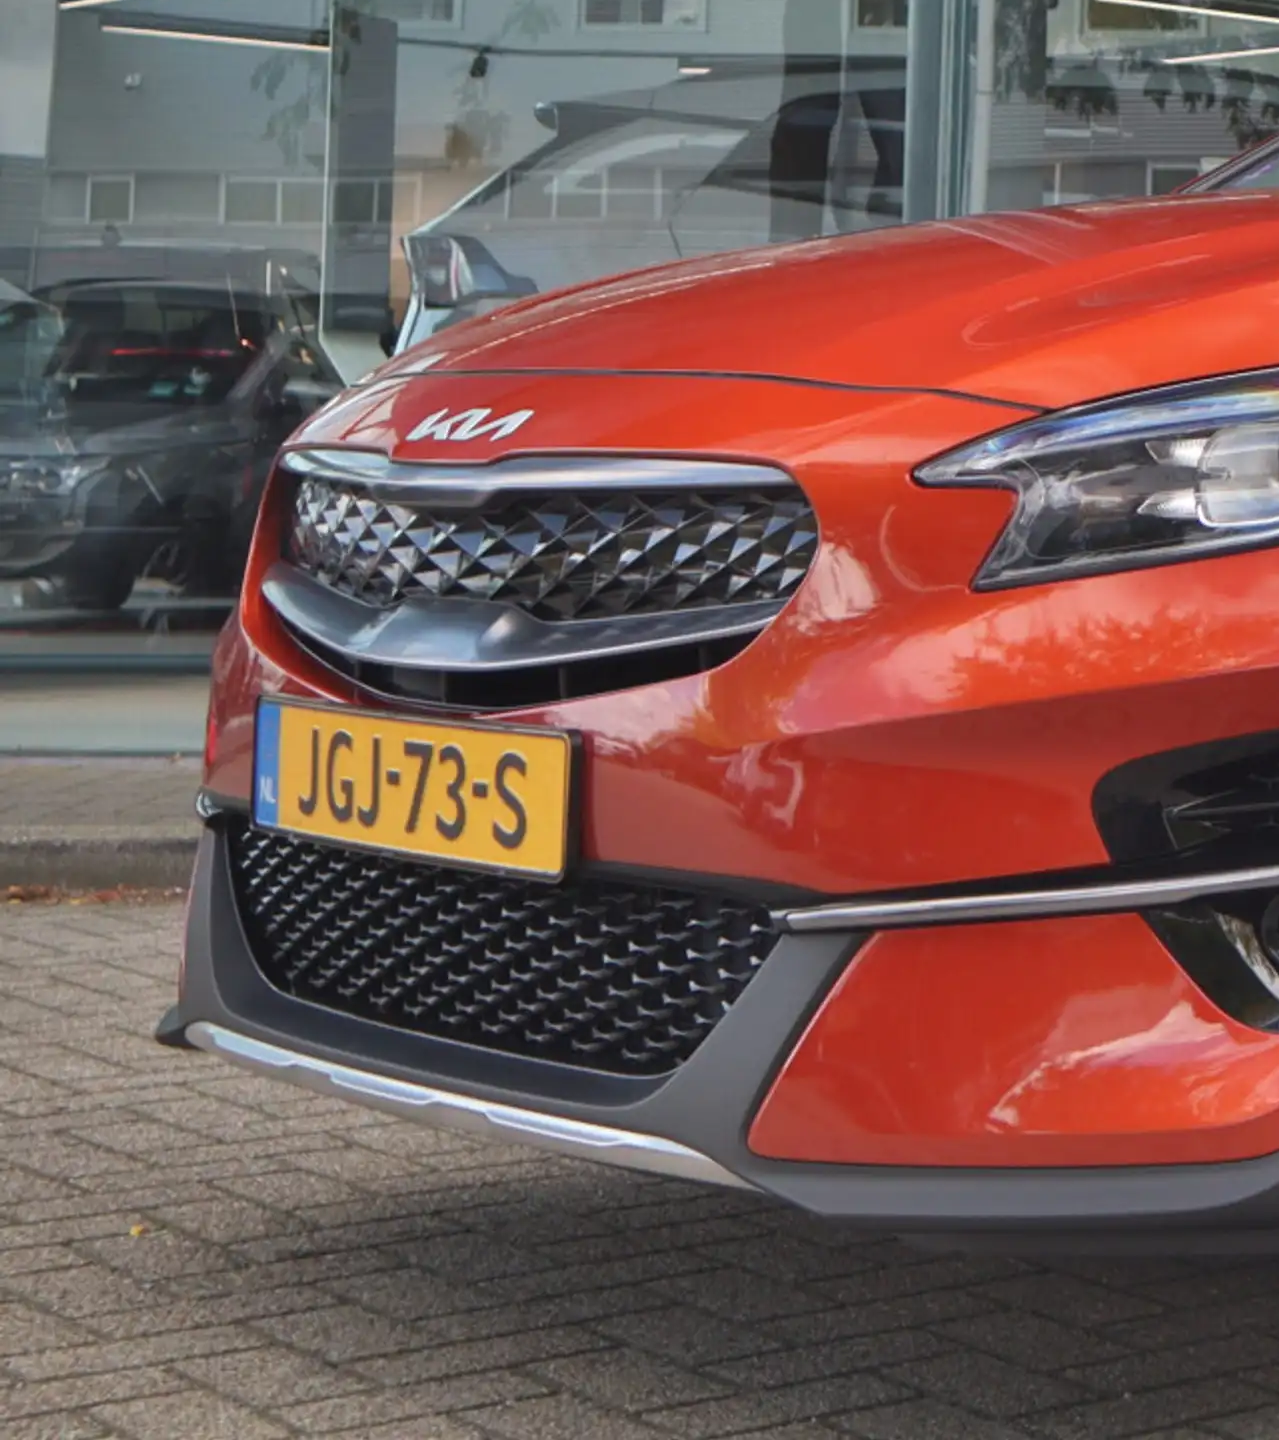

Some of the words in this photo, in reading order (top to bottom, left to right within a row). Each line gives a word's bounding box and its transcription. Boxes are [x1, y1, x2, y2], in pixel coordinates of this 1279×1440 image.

[405, 408, 535, 442] KIA
[258, 775, 277, 805] NL
[298, 726, 528, 850] JGJ-73-S
